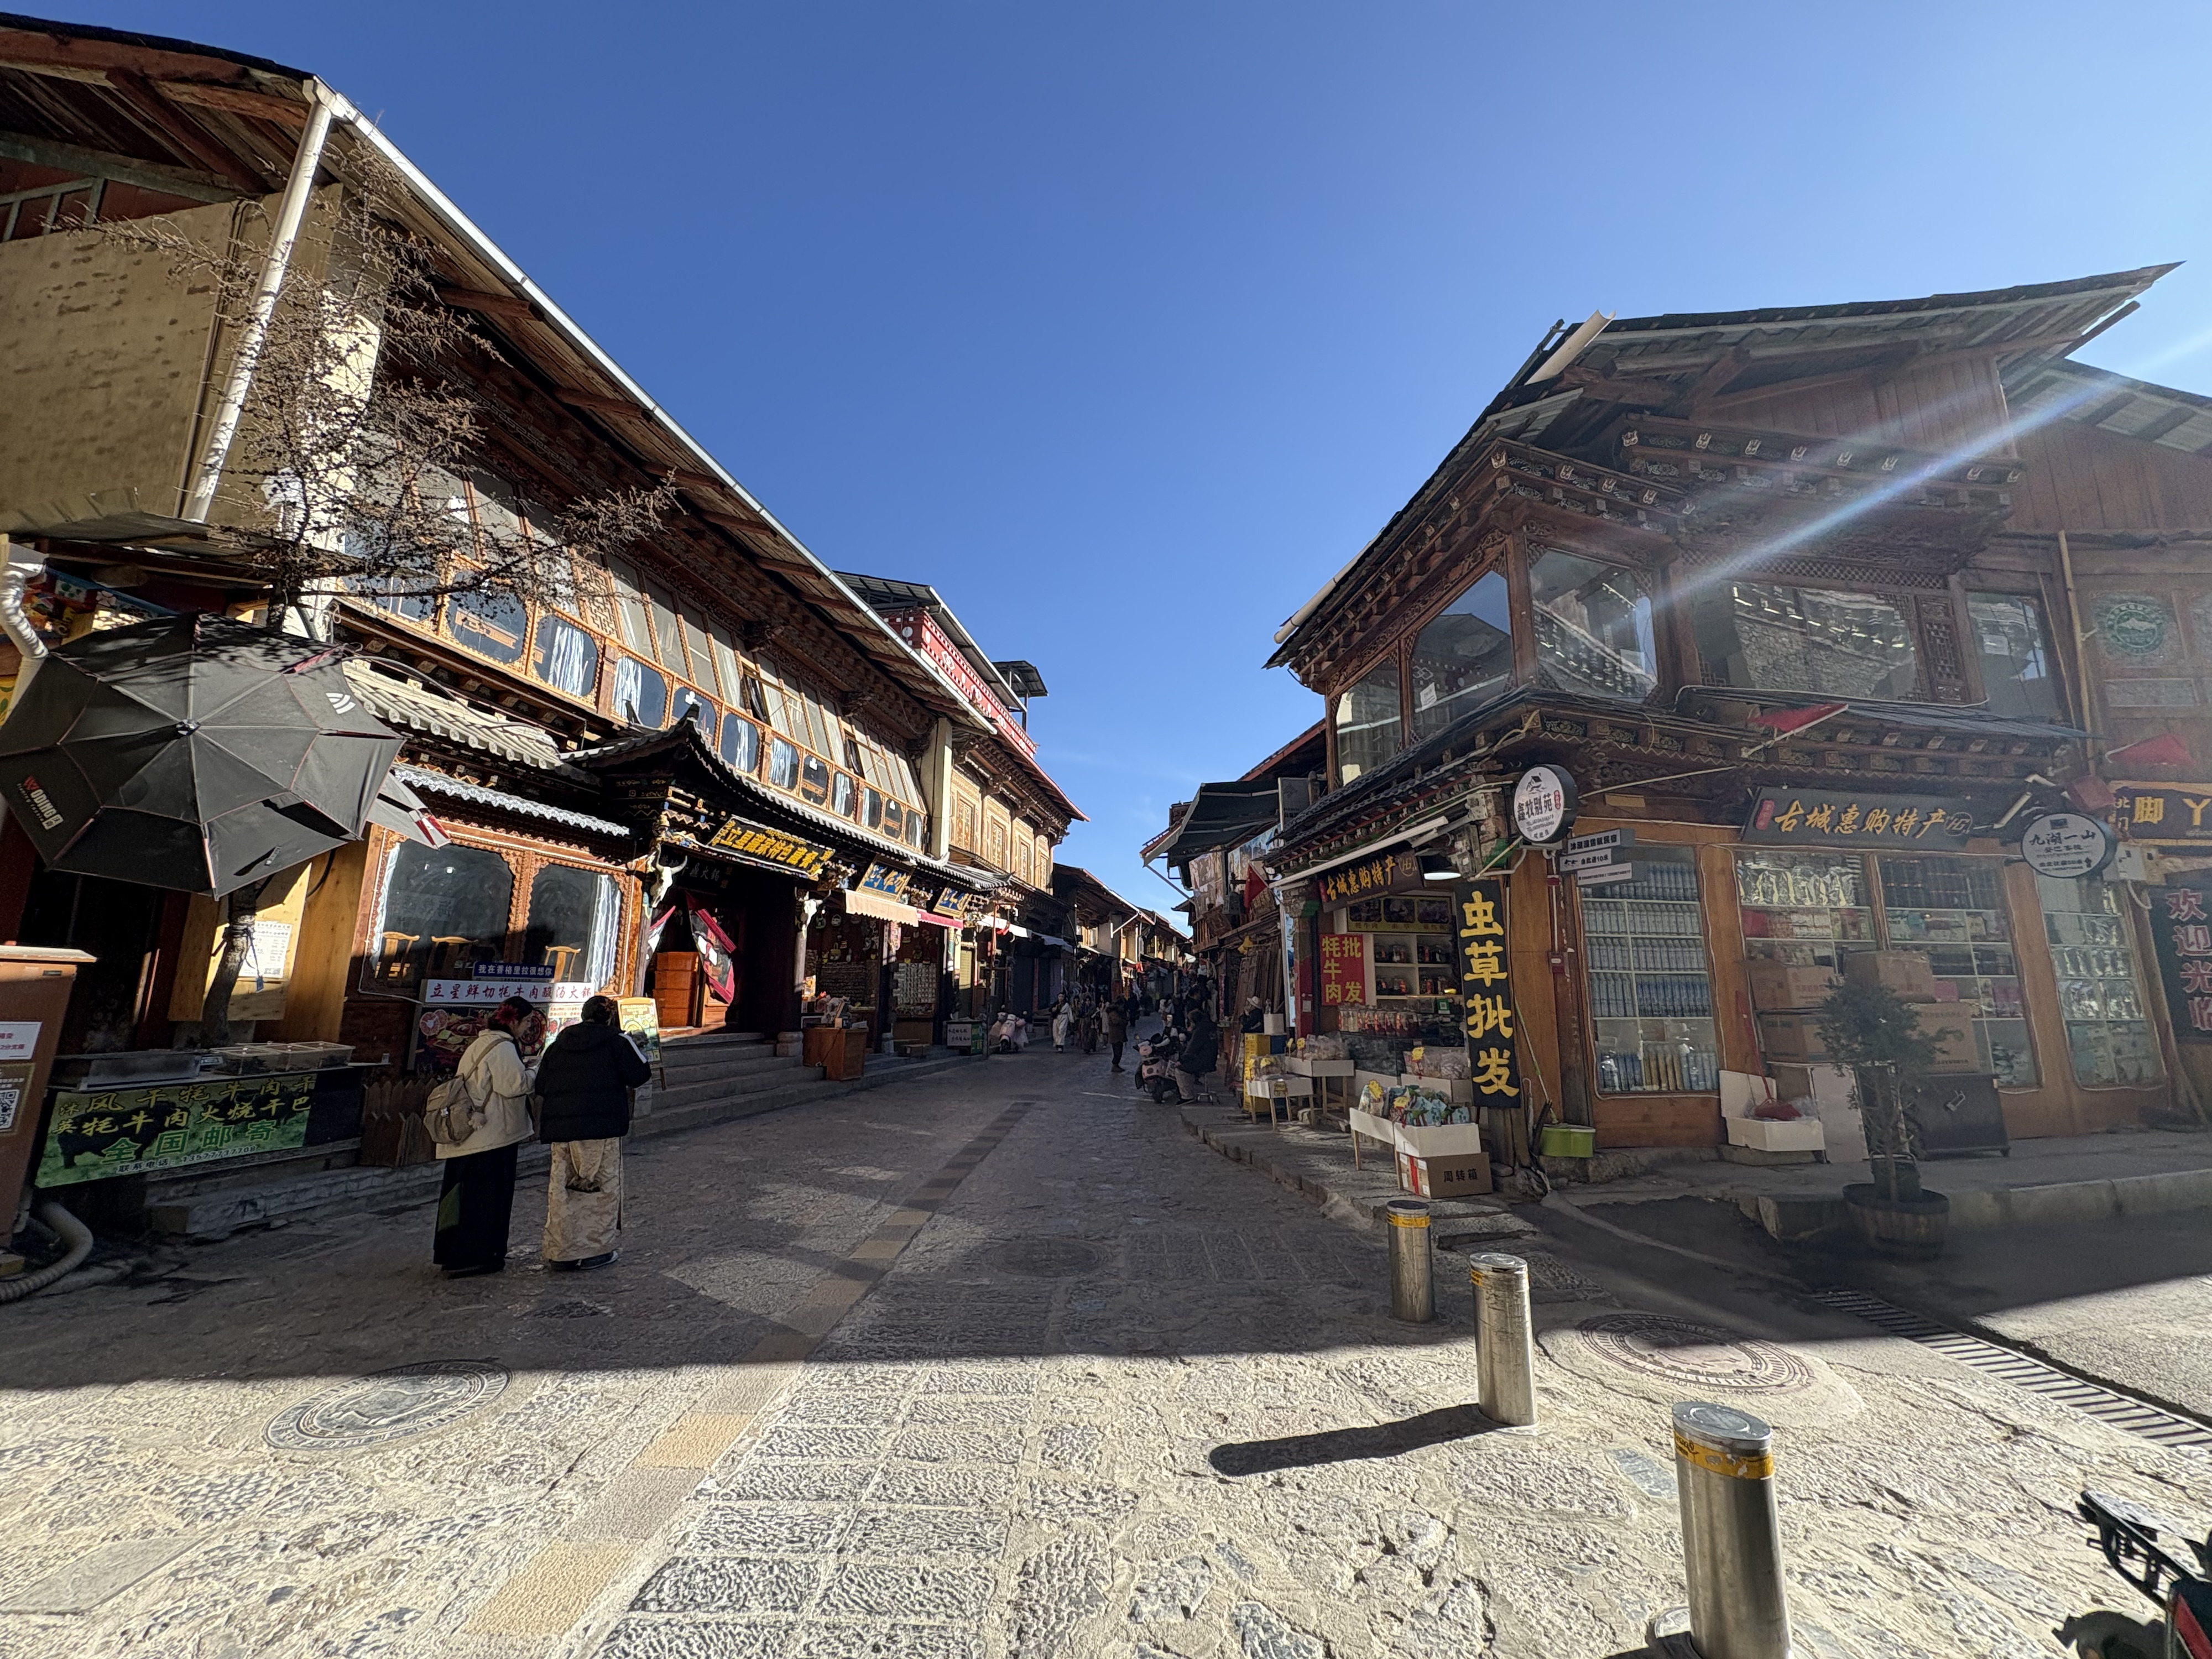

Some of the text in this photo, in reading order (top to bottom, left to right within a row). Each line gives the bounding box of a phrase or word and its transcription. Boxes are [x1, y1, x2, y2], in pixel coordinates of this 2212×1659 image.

[1775, 800, 1946, 838] 古城惠购特产
[1326, 854, 1396, 901] 古城惠购特产
[478, 964, 553, 976] 我在香格里拉很想你
[1460, 891, 1520, 1097] 虫草批发
[101, 1119, 278, 1164] 全国邮寄
[1444, 1168, 1478, 1183] 周转箱
